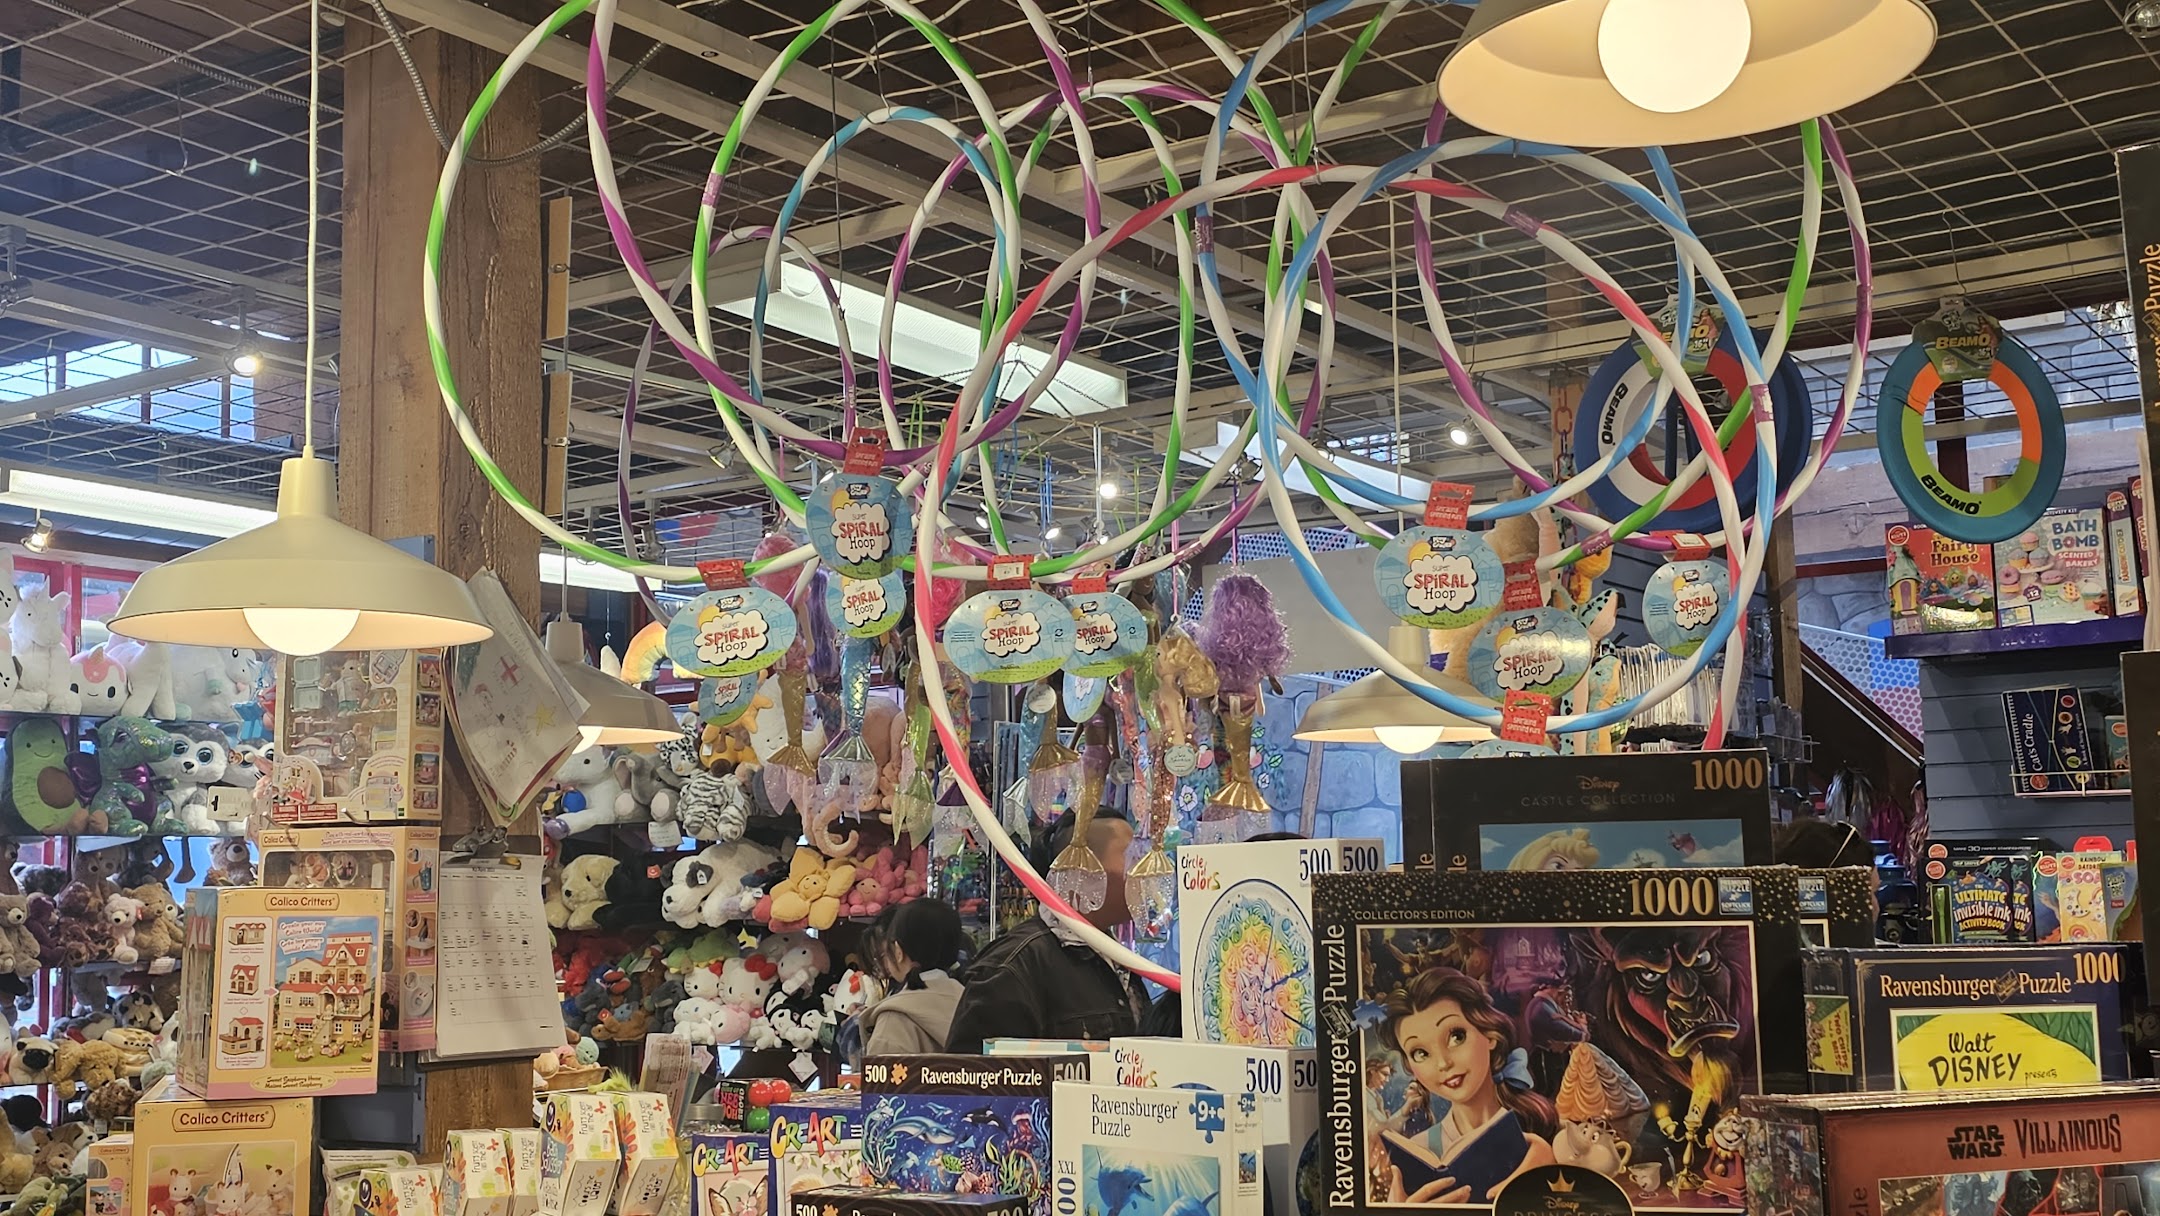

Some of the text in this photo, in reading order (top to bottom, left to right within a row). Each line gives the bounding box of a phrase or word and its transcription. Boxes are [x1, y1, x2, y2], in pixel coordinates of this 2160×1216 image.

[1601, 382, 1629, 445] BEAMO
[1921, 474, 1980, 515] BEAMO
[2052, 519, 2097, 535] BATH
[1932, 540, 1977, 554] Fairy
[2051, 535, 2099, 551] BOMB
[1930, 552, 1979, 567] House
[1424, 586, 1457, 601] Hoop
[714, 640, 748, 655] Hoop
[1513, 664, 1545, 680] Hoop
[2022, 713, 2043, 771] Cat's Cradle
[1691, 757, 1763, 791] 1000
[1520, 793, 1676, 807] CASTLE COLLECTION
[1181, 853, 1204, 869] Circle
[1299, 848, 1331, 881] 500
[1343, 846, 1379, 872] 500
[270, 896, 333, 906] Calico Critters
[1628, 876, 1714, 916] 1000
[1955, 889, 2007, 904] ULTIMATE
[1354, 909, 1475, 921] COLLECTOR'S EDITION
[1953, 901, 2011, 922] invisible ink
[2014, 906, 2031, 923] ink
[1321, 924, 1347, 1002] Puzzle
[2073, 952, 2120, 985] 1000
[1880, 974, 1997, 999] Ravensburger
[2019, 972, 2072, 994] Puzzle
[1948, 1032, 1997, 1054] Walt
[1114, 1048, 1141, 1067] Circle
[865, 1064, 1042, 1089] 500 Ravensburger Puzzle
[1054, 1061, 1087, 1082] 500
[1246, 1057, 1281, 1095] 500
[1294, 1059, 1317, 1087] 50
[1928, 1053, 2023, 1087] DISNEY
[2025, 1068, 2058, 1085] presents
[180, 1111, 265, 1125] Calico Critters
[1092, 1093, 1178, 1123] Ravensburger
[1198, 1100, 1217, 1121] 9+
[1092, 1115, 1131, 1137] Puzzle
[1327, 1037, 1355, 1208] Ravensburger
[1947, 1125, 2004, 1143] STAR
[2013, 1113, 2122, 1159] VILLAINOUS
[1948, 1142, 2005, 1160] WARS
[1057, 1160, 1076, 1175] XXL
